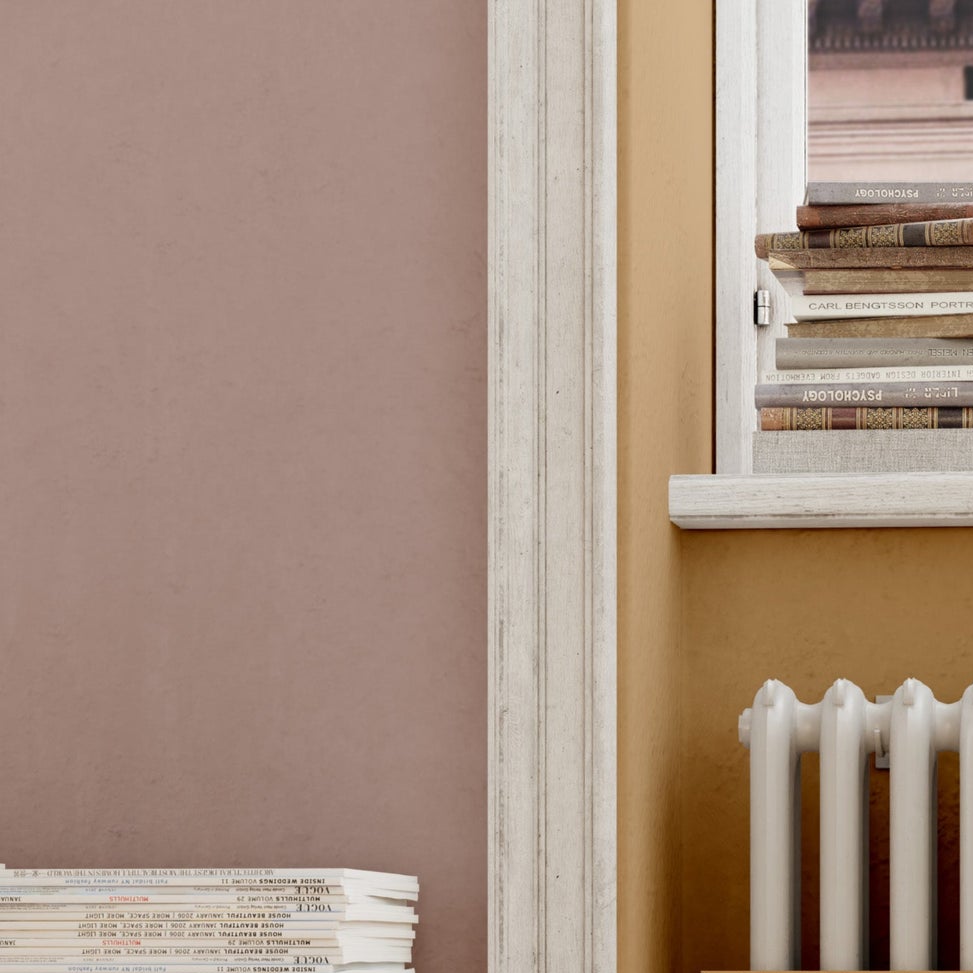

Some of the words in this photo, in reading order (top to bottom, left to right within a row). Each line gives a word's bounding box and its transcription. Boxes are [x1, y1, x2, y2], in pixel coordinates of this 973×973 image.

[854, 189, 919, 198] PSYCHOLOGY
[808, 302, 842, 311] CARL
[845, 301, 924, 310] BENGTSSON
[928, 348, 958, 357] MEISEL
[766, 374, 816, 382] EVERMOTION
[820, 373, 841, 381] FROM
[846, 372, 881, 380] GADGETS
[886, 371, 918, 379] DESIGN
[921, 370, 961, 378] INTERIOR
[802, 389, 882, 401] PSYCHOLOGY
[295, 886, 330, 894] VOGUE
[296, 904, 332, 912] VOGUE
